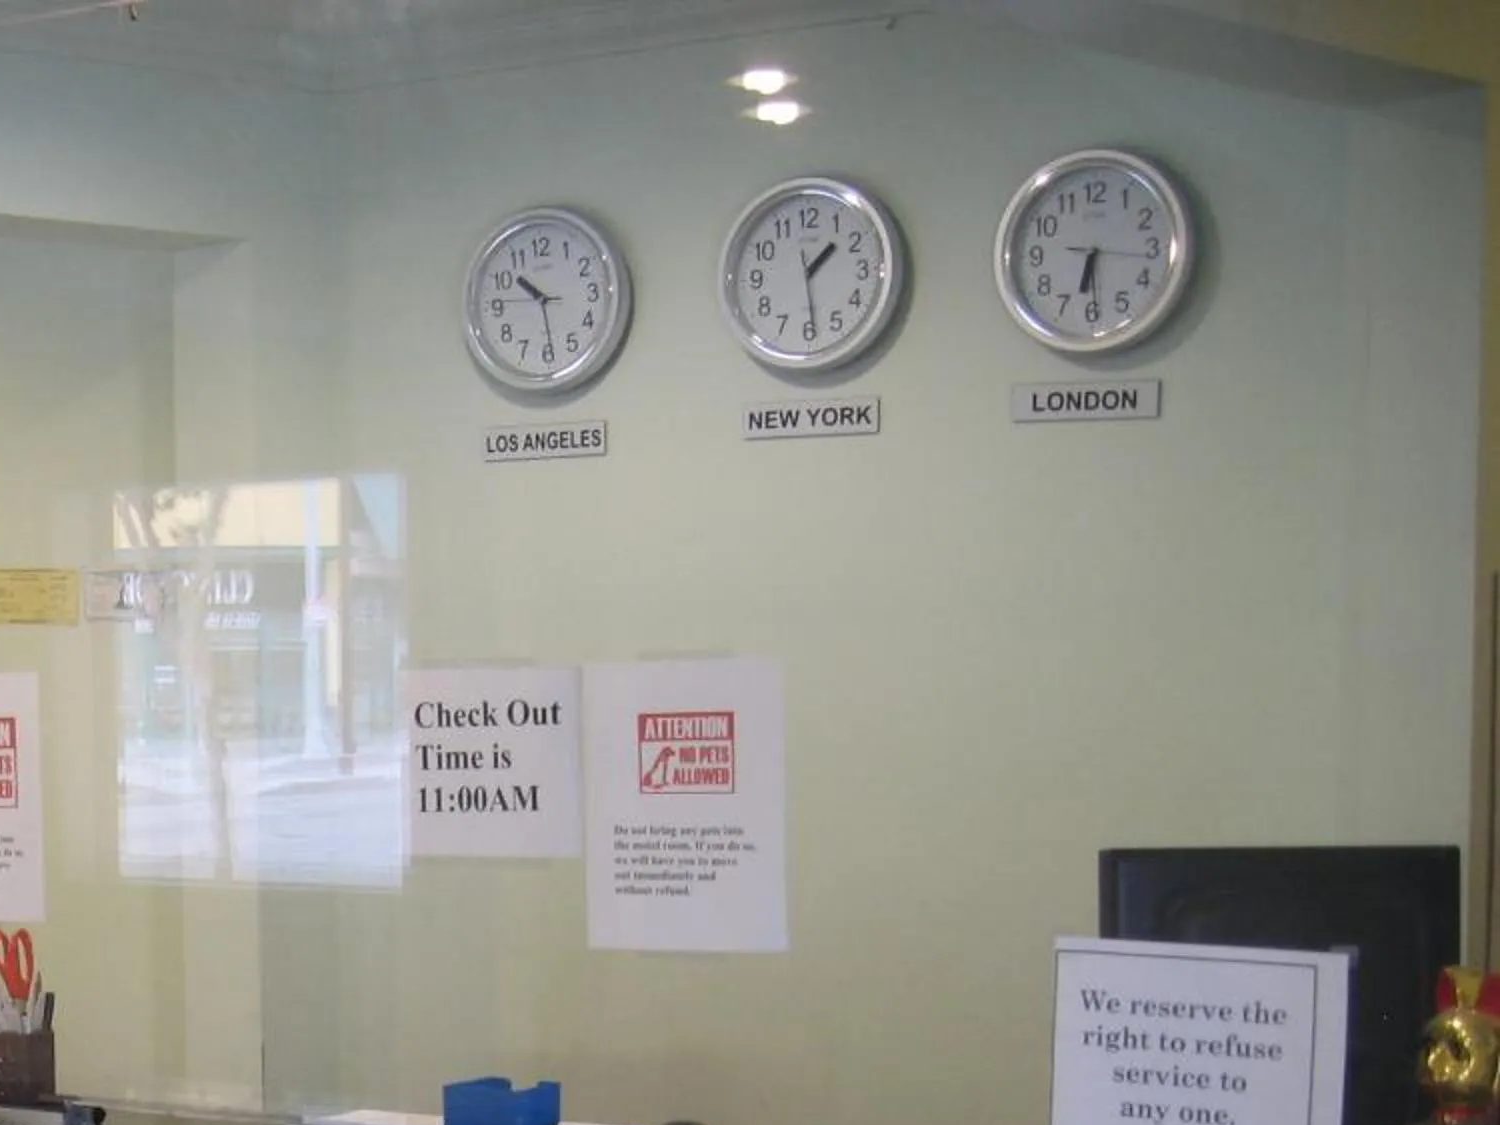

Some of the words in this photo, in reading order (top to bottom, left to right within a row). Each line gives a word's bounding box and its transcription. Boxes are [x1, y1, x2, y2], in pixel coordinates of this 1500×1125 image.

[1084, 181, 1106, 204] 12
[1121, 189, 1128, 209] 1
[1058, 193, 1075, 214] 11
[800, 208, 819, 228] 12
[833, 213, 839, 233] 1
[1036, 215, 1058, 238] 10
[1138, 208, 1153, 231] 2
[775, 219, 791, 239] 11
[532, 237, 550, 257] 12
[563, 241, 569, 260] 1
[756, 240, 775, 261] 10
[849, 232, 861, 253] 2
[1145, 237, 1159, 259] 3
[511, 249, 525, 269] 11
[1029, 245, 1044, 267] 9
[578, 257, 590, 277] 2
[856, 260, 869, 280] 3
[495, 271, 512, 290] 10
[750, 270, 763, 289] 9
[1037, 274, 1051, 296] 8
[1136, 268, 1149, 288] 4
[587, 283, 599, 302] 3
[849, 289, 861, 308] 4
[1115, 291, 1129, 313] 5
[491, 299, 504, 317] 9
[758, 296, 771, 317] 8
[1057, 294, 1071, 316] 7
[1085, 301, 1099, 323] 6
[582, 310, 594, 329] 4
[776, 314, 788, 336] 7
[830, 310, 843, 331] 5
[501, 323, 512, 343] 8
[803, 321, 817, 341] 6
[518, 339, 529, 360] 7
[542, 343, 555, 363] 6
[566, 333, 579, 352] 5
[1031, 389, 1138, 412] LONDON
[748, 408, 800, 430] NEW
[806, 405, 871, 427] YORK
[486, 433, 519, 453] LOS
[523, 429, 602, 451] ANGELES
[414, 700, 499, 729] Check
[507, 698, 562, 727] Out
[644, 715, 729, 739] ATTENTION
[415, 743, 484, 771] Time
[493, 742, 512, 769] is
[678, 746, 696, 763] NO
[699, 745, 729, 763] PETS
[672, 767, 729, 785] ALLOWED
[419, 785, 540, 813] 11:00AM
[1080, 988, 1122, 1015] We
[1129, 997, 1234, 1024] reserve
[1242, 1001, 1288, 1026] the
[1082, 1024, 1150, 1054] right
[1159, 1034, 1186, 1054] to
[1195, 1032, 1283, 1061] refuse
[1112, 1064, 1212, 1091] service
[1220, 1071, 1248, 1094] to
[1119, 1099, 1171, 1125] any
